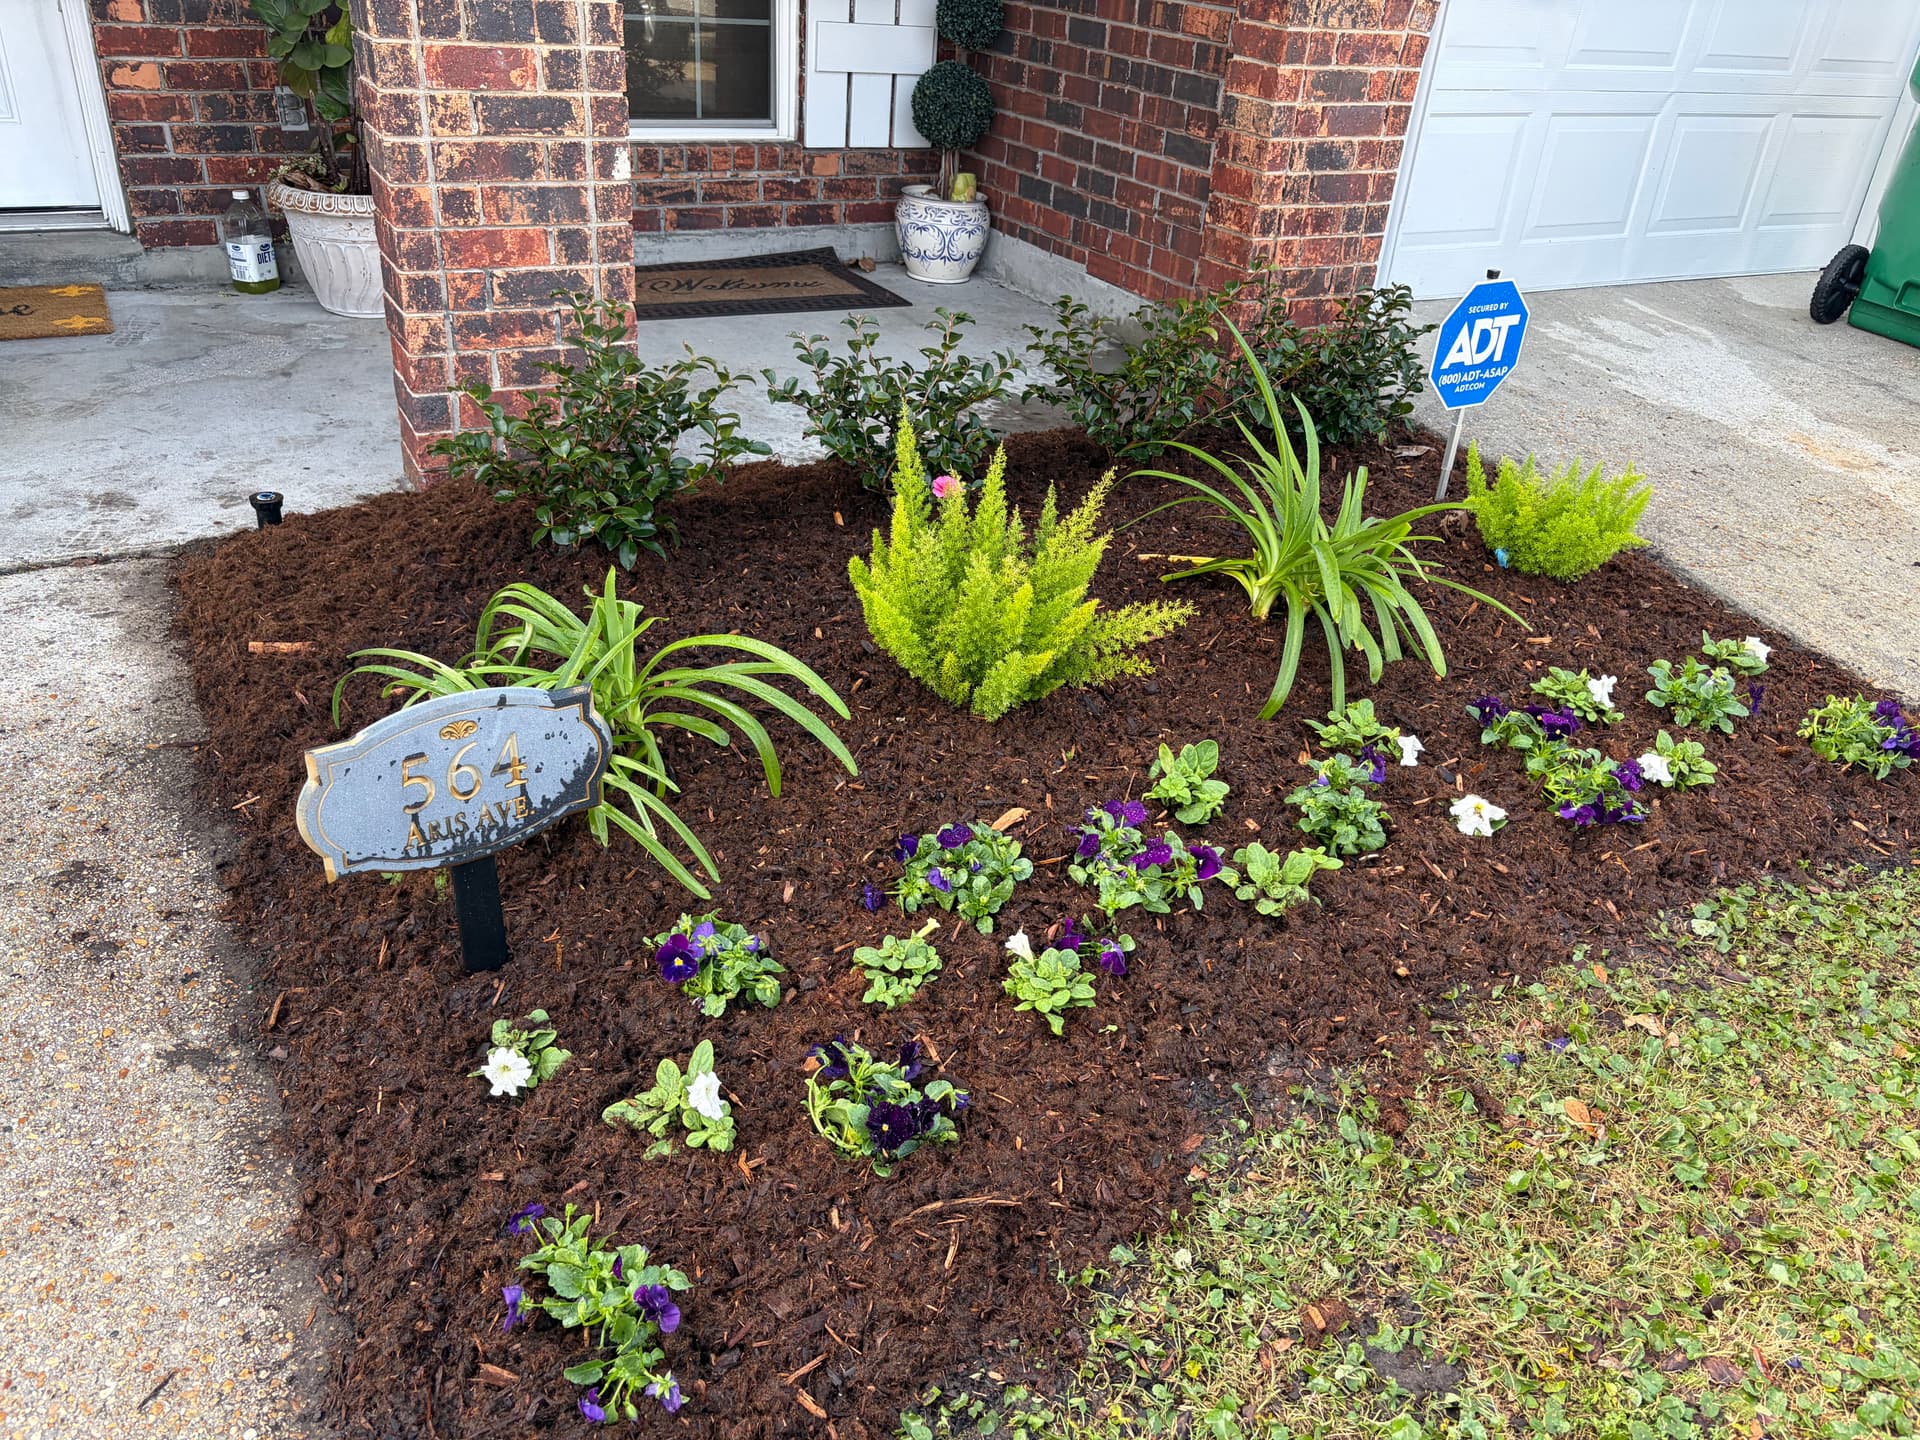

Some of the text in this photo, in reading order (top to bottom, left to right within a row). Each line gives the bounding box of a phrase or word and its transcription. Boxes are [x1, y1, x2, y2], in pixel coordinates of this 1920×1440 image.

[257, 251, 272, 264] DIET
[638, 275, 825, 294] Welcome
[1468, 302, 1509, 314] SECURED BY
[1440, 314, 1521, 369] ADT
[1454, 382, 1485, 393] ADT.COM
[402, 731, 529, 815] 564
[404, 795, 536, 850] ARIS AVE.
